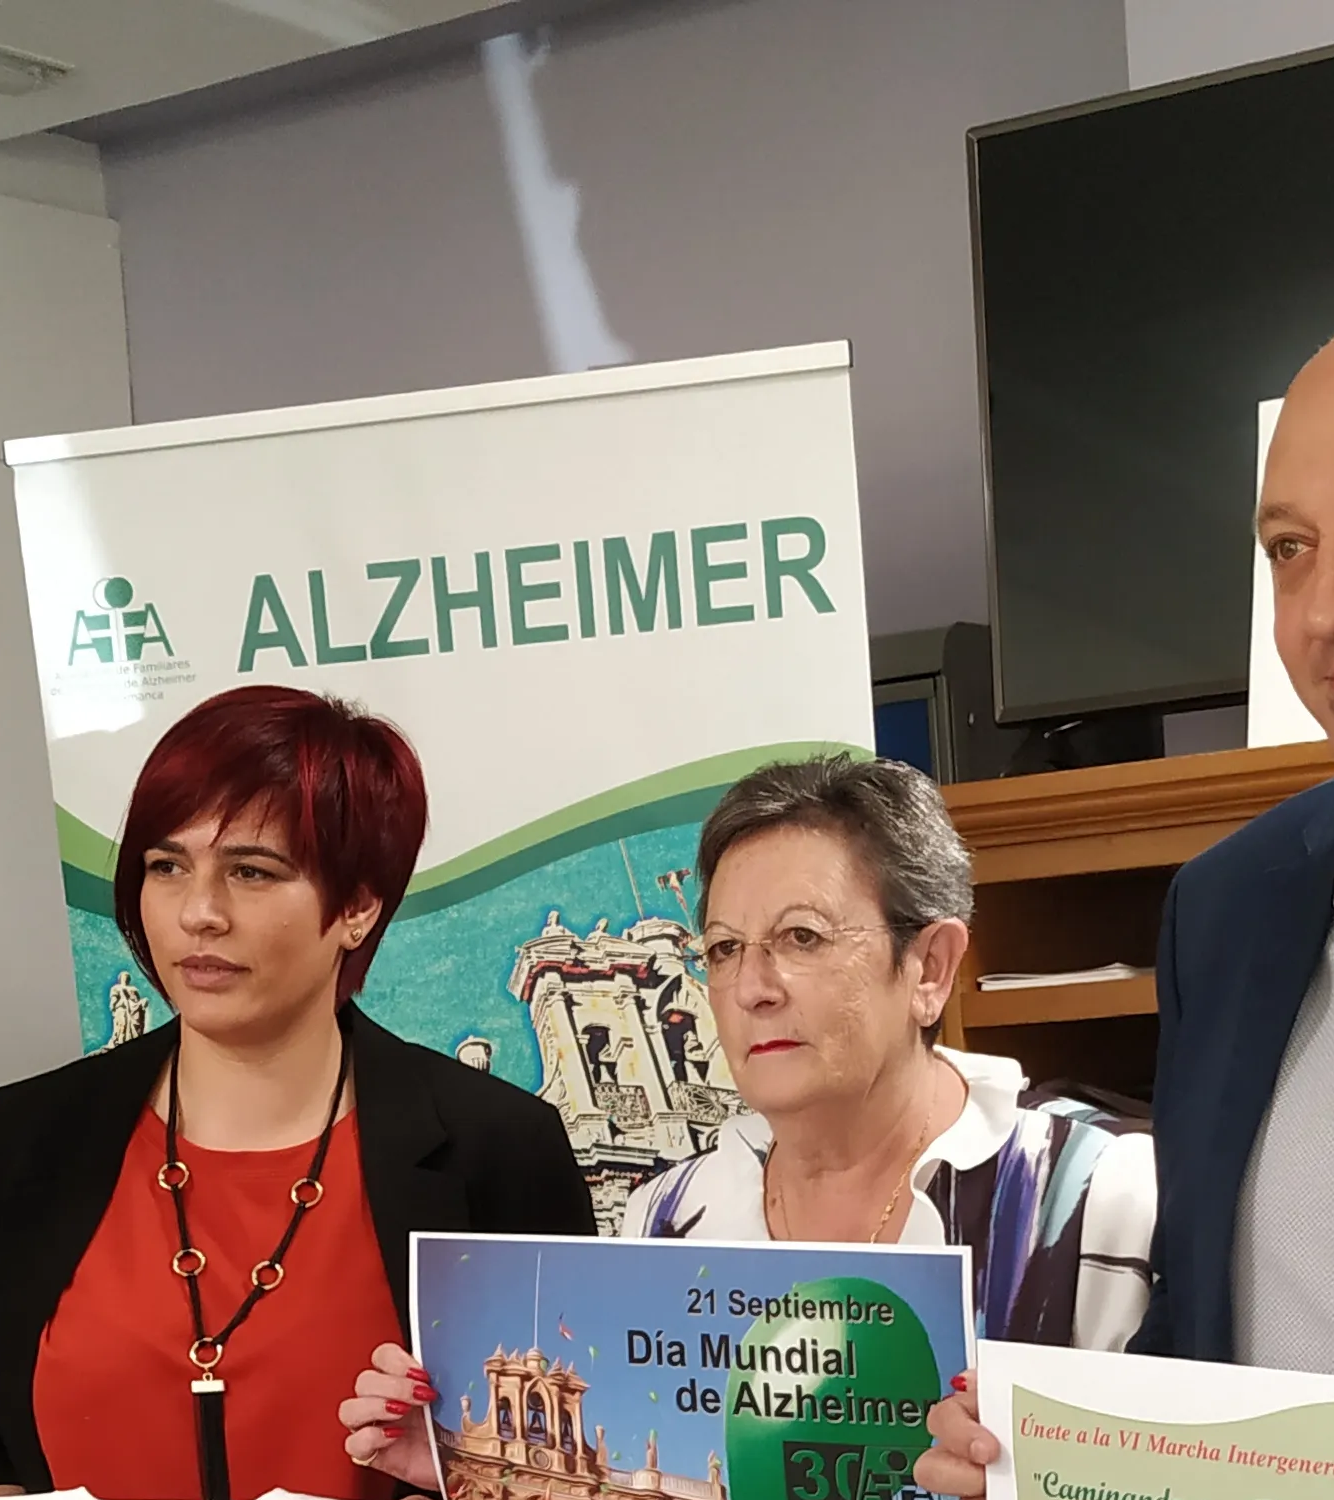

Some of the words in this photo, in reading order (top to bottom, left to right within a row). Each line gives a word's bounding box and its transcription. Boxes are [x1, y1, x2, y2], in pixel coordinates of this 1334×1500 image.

[237, 515, 837, 673] ALZHEIMER
[133, 658, 191, 676] Familiares
[141, 672, 197, 687] Alzheimer
[687, 1287, 716, 1315] 21
[728, 1289, 895, 1325] Septiembre
[627, 1329, 687, 1367] Día
[700, 1332, 857, 1378] Mundial
[675, 1378, 722, 1414] de
[1019, 1412, 1071, 1441] Únete
[1076, 1430, 1088, 1445] a
[1093, 1427, 1111, 1447] la
[1118, 1430, 1141, 1451] VI
[1146, 1433, 1221, 1461] Marcha
